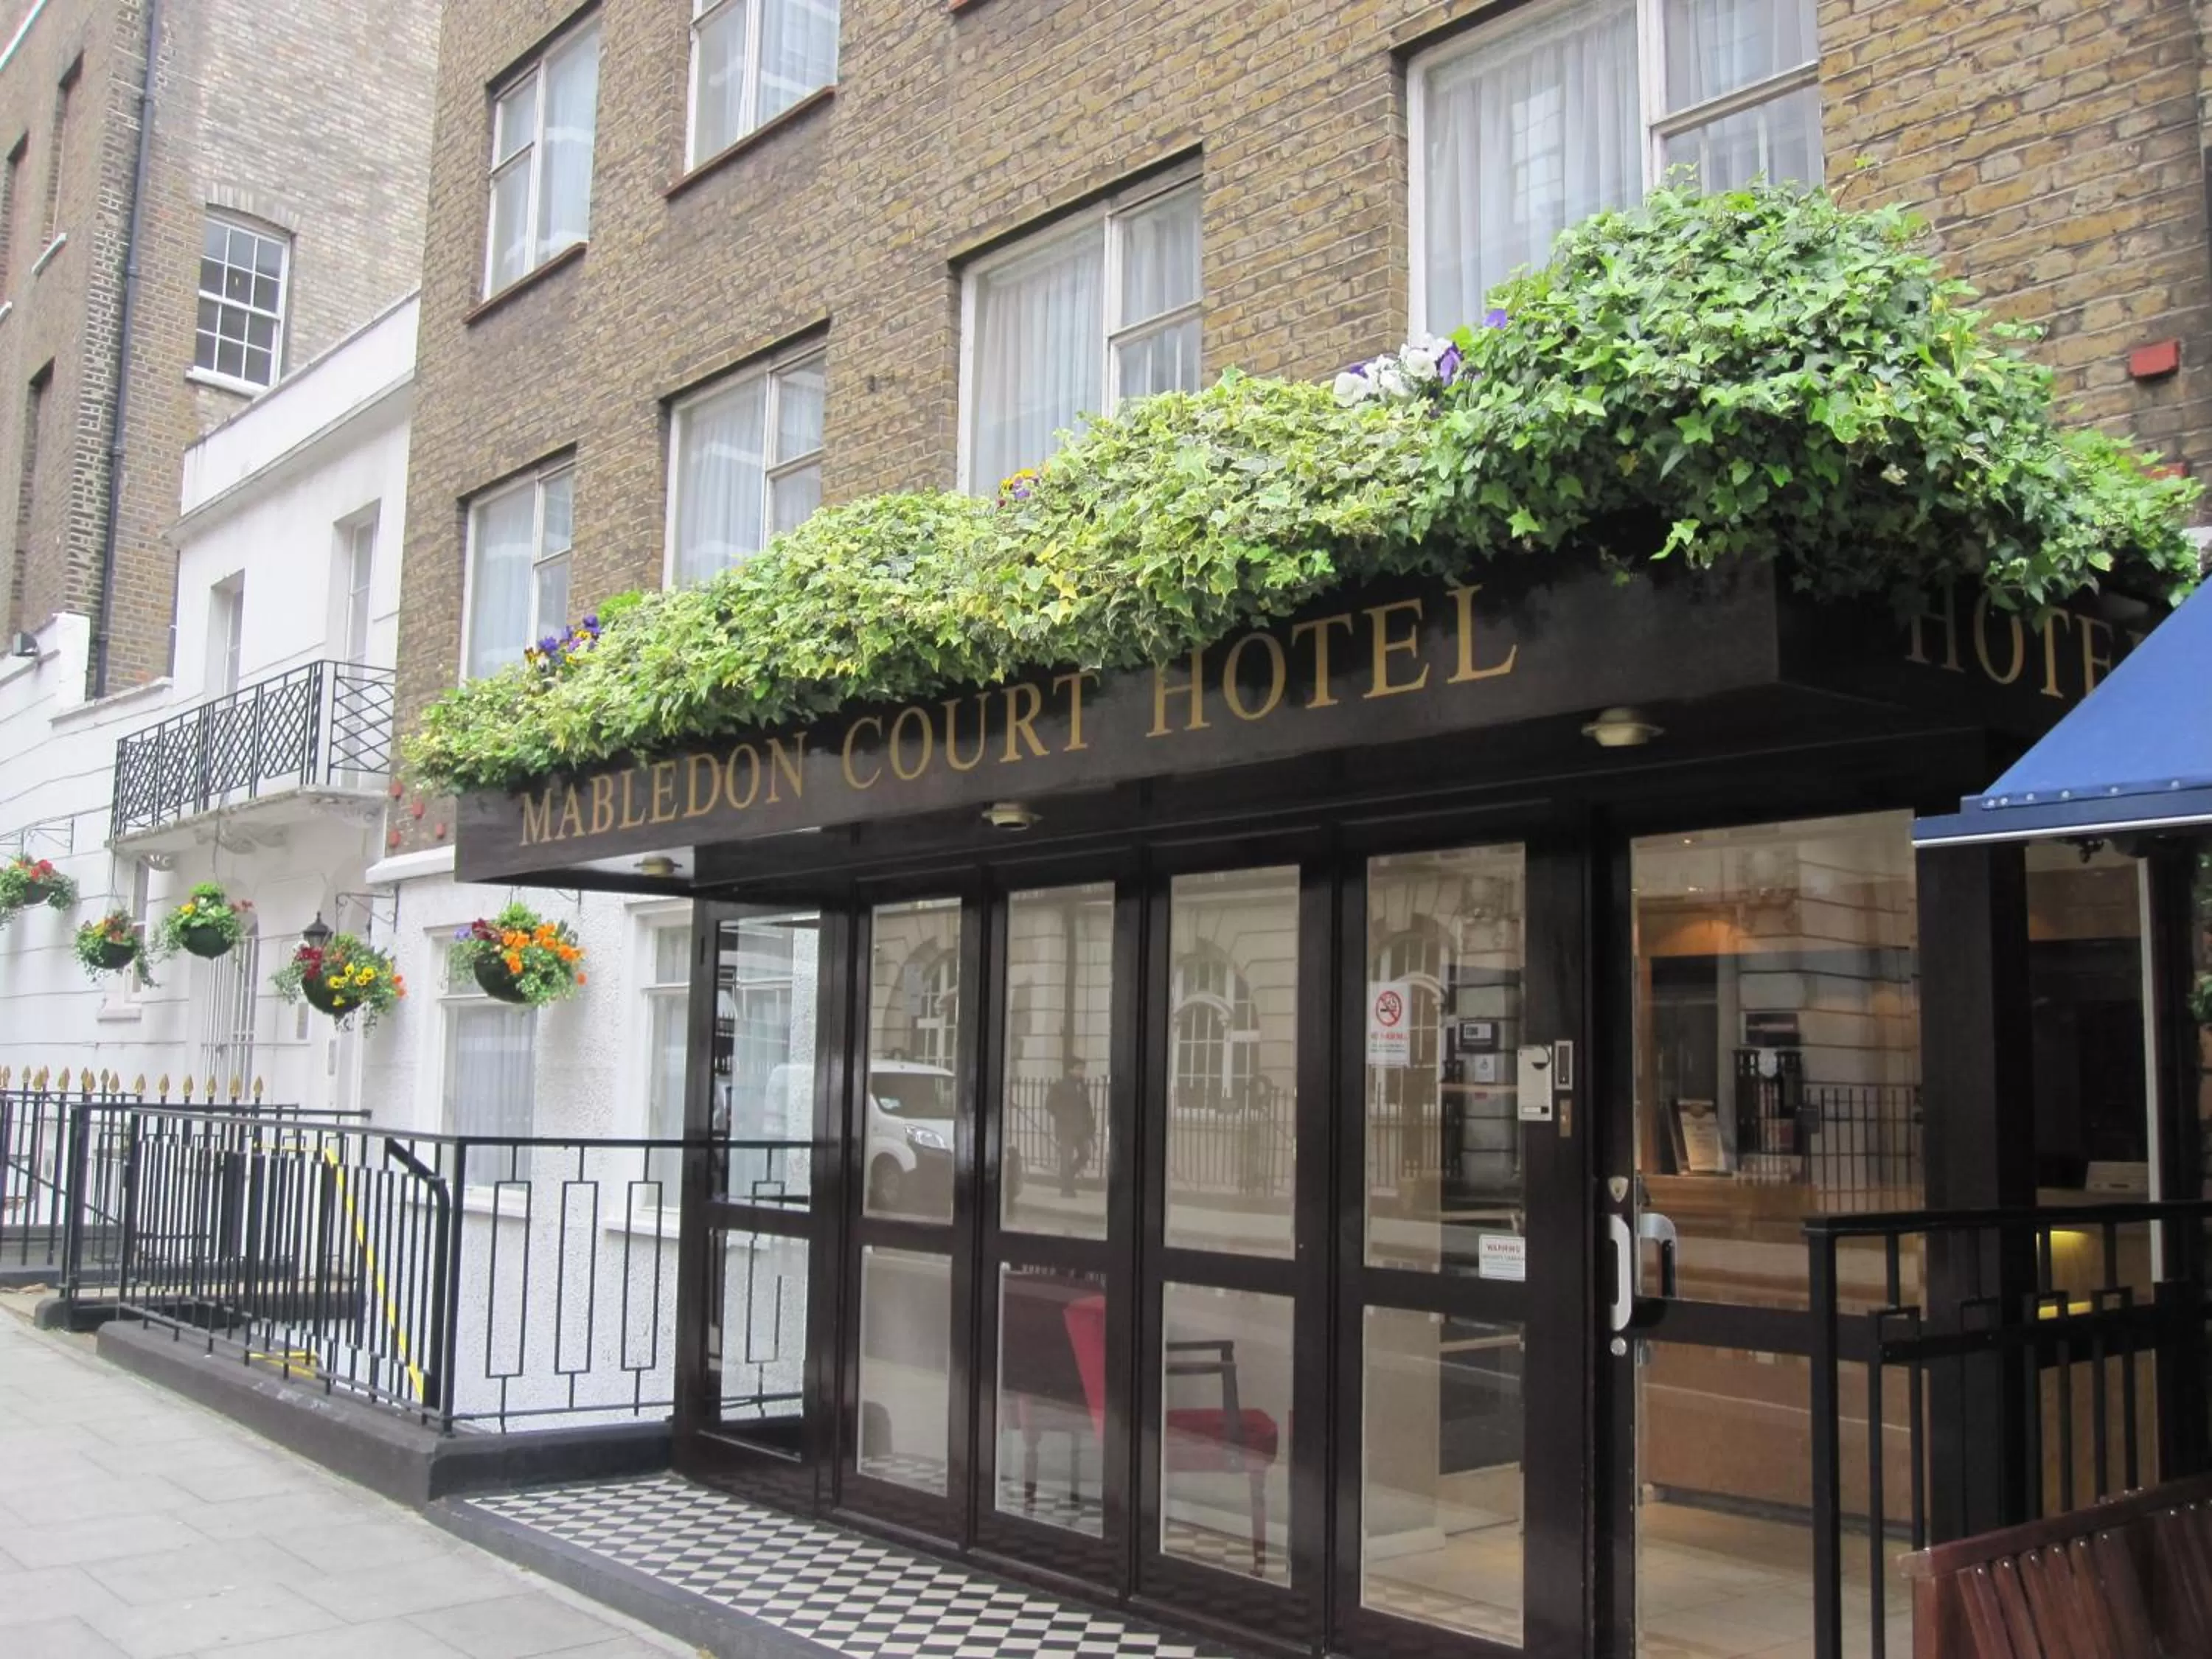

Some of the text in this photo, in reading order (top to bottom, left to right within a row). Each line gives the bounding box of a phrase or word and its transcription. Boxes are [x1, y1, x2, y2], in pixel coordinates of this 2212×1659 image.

[519, 583, 1517, 847] MABLEDON COURT HOTEL
[1905, 582, 2146, 699] HOTE
